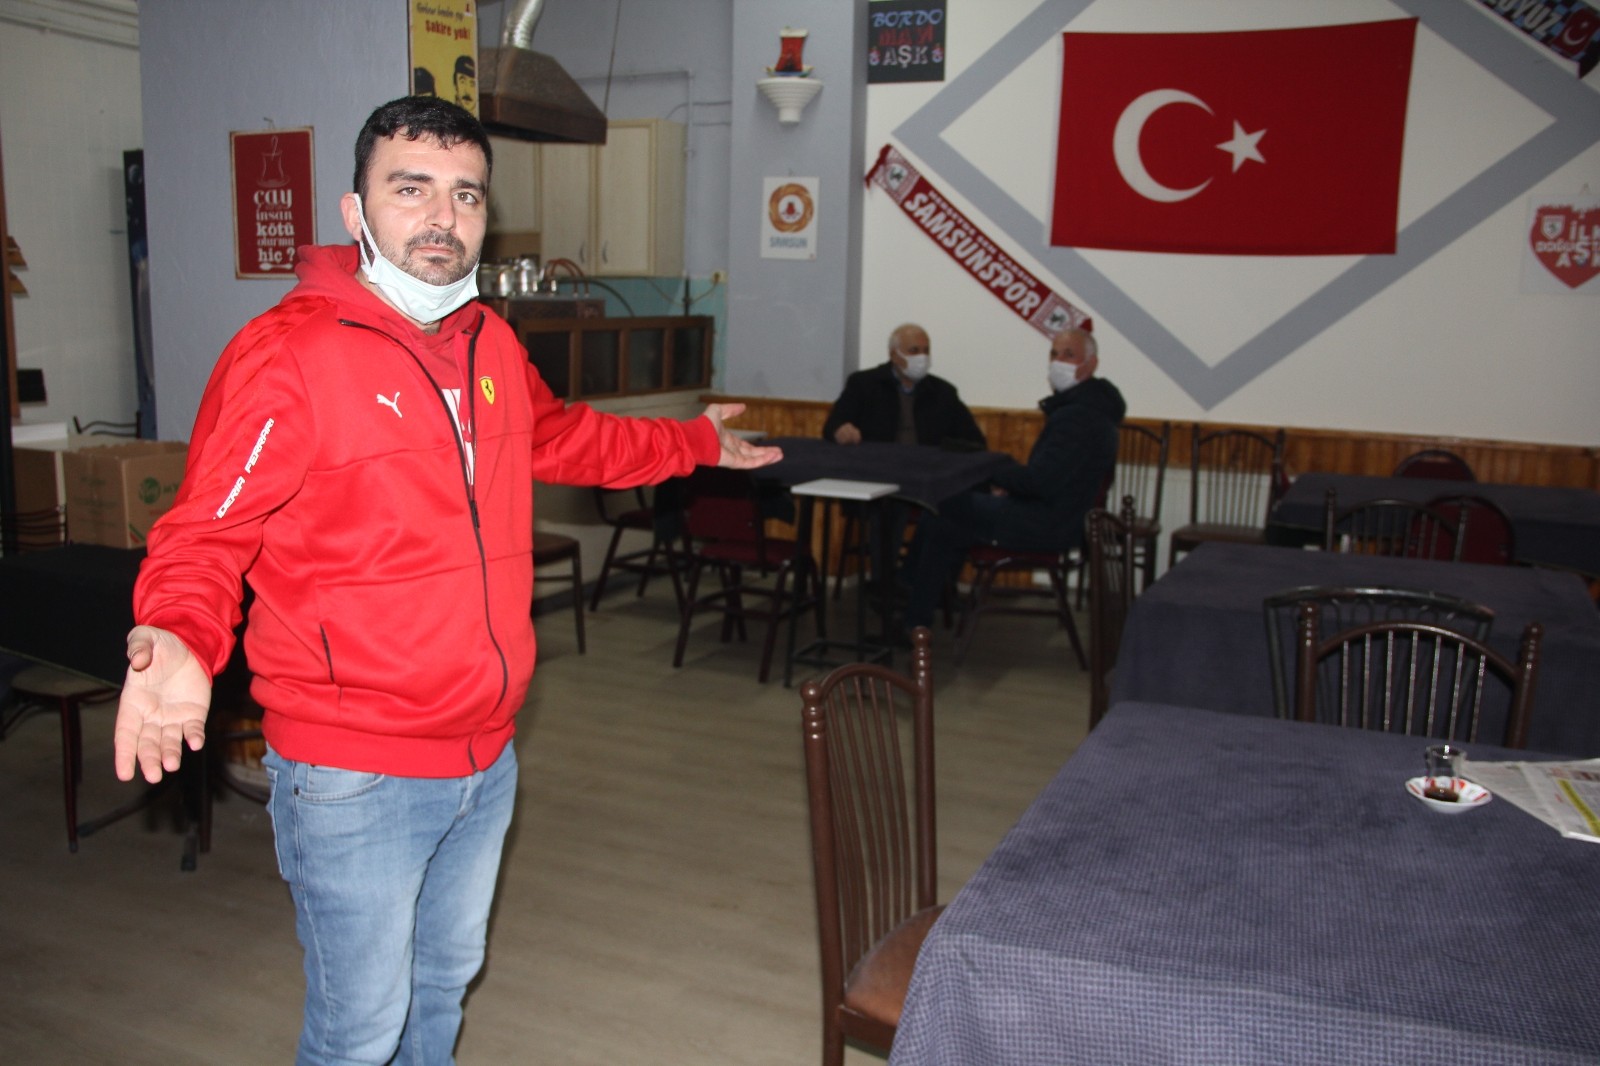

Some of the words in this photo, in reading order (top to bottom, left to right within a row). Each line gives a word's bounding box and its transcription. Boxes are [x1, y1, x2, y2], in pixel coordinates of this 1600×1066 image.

[872, 9, 943, 28] BORDO
[882, 44, 929, 68] AŞK
[253, 189, 293, 208] çay
[256, 222, 294, 237] kötü
[904, 192, 1041, 317] SAMSUNSPOR
[245, 417, 275, 474] FERRARI
